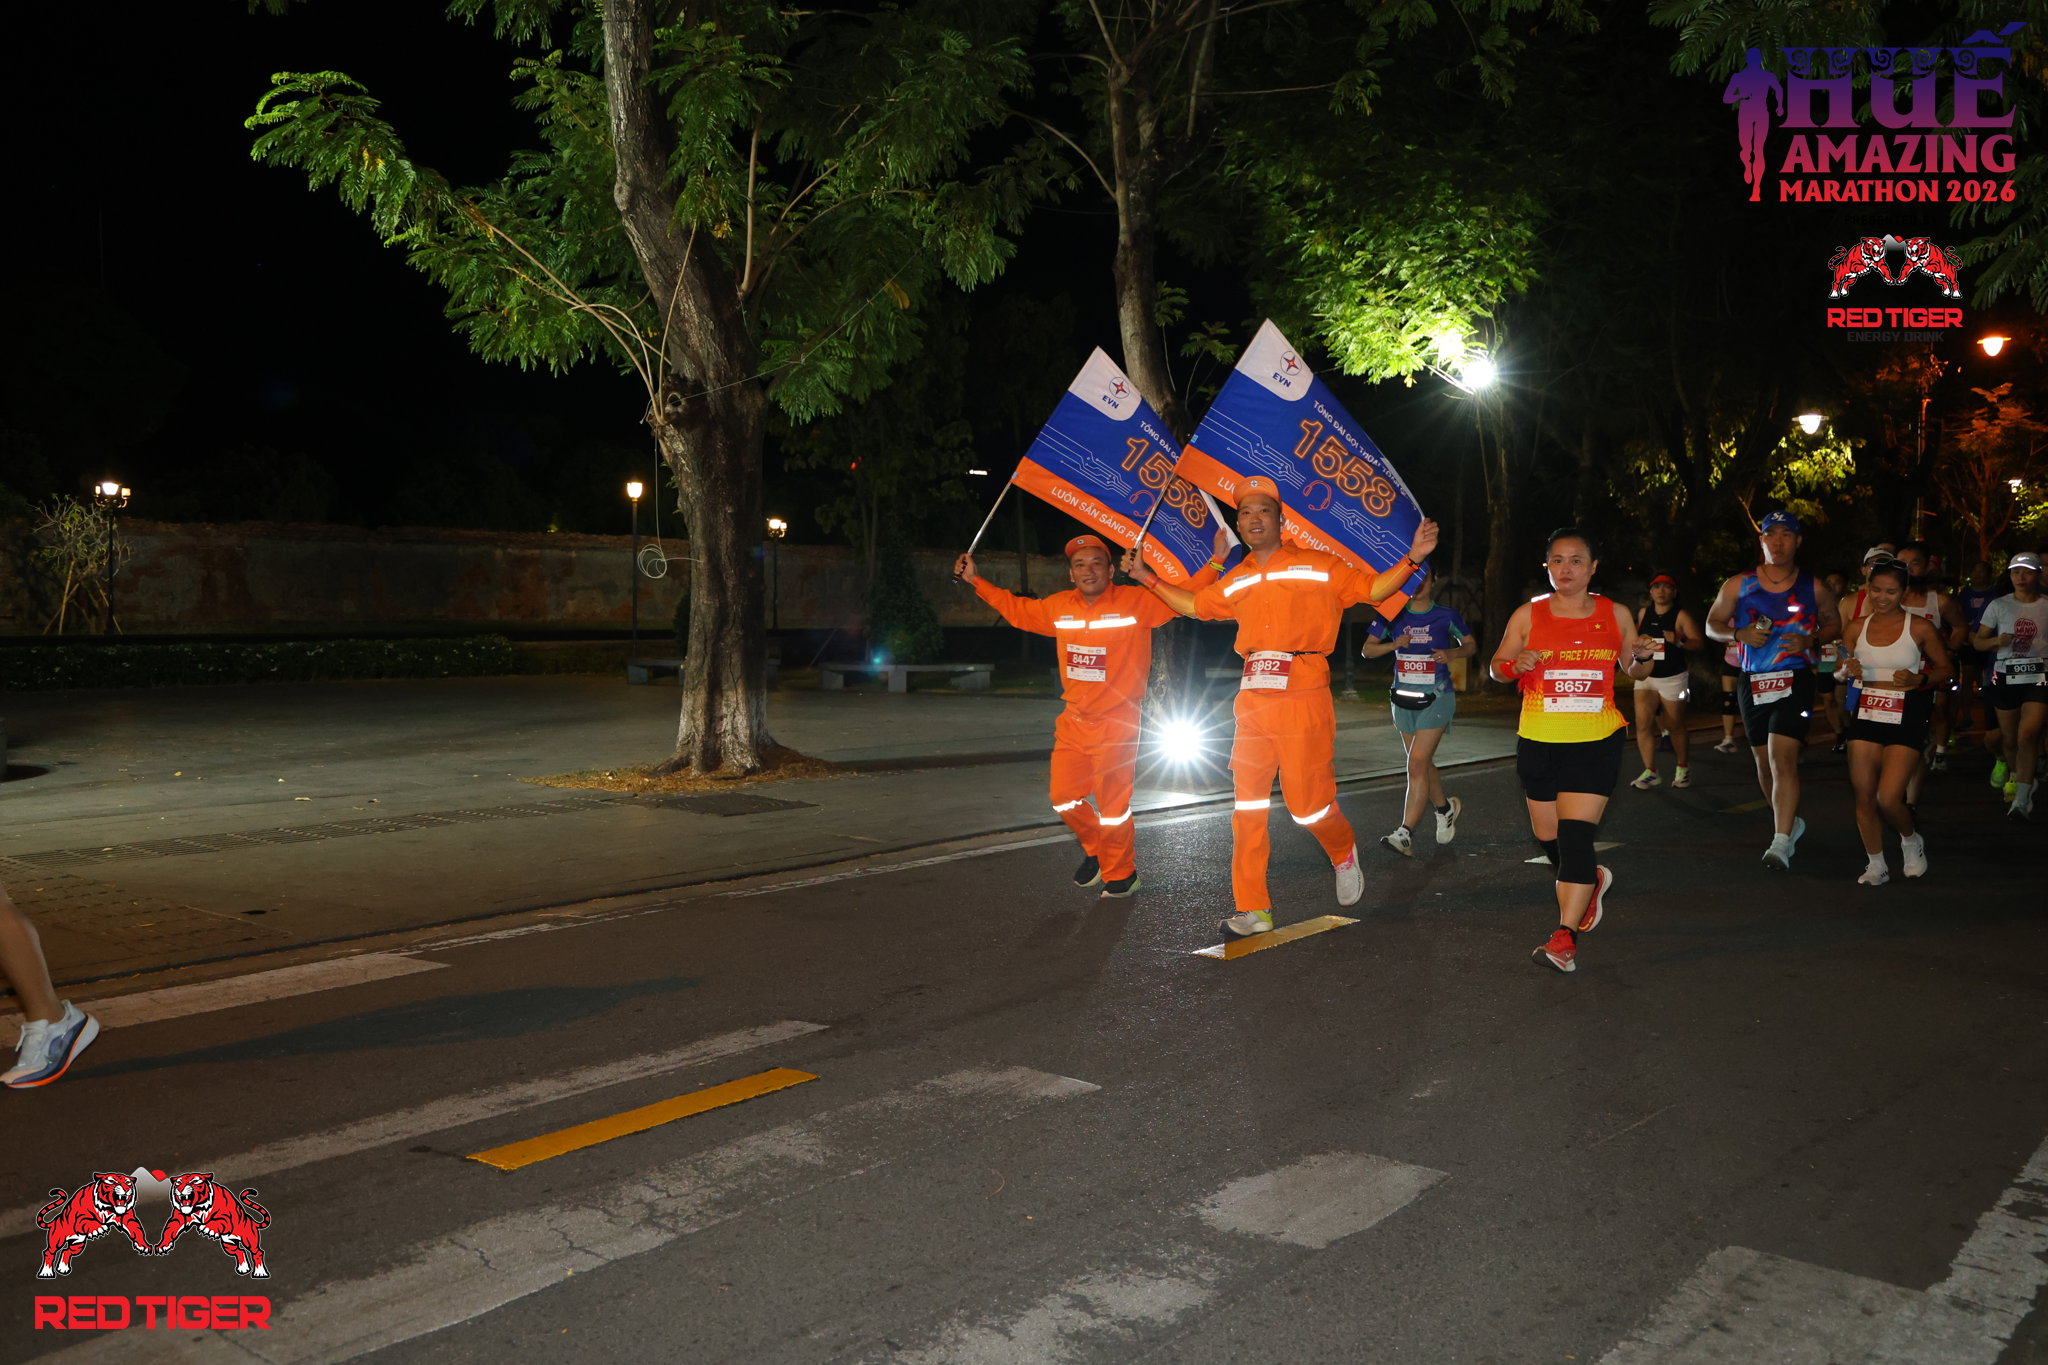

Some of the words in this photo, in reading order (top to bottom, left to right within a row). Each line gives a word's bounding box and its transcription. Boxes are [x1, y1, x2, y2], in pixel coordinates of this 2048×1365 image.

[1272, 372, 1292, 388] EVN
[1102, 394, 1119, 409] EVN
[1294, 419, 1397, 518] 1558
[1121, 437, 1208, 528] 1558
[1051, 486, 1079, 507] LUÔN
[1099, 514, 1126, 534] SÀNG
[1164, 561, 1180, 578] 24/7
[1073, 654, 1097, 665] 8447
[1560, 650, 1582, 661] PACE
[1582, 650, 1588, 661] 7
[1588, 649, 1617, 661] FAMILY
[1251, 660, 1280, 672] 8982
[1404, 661, 1426, 671] 8061
[2014, 664, 2036, 673] 9013
[1555, 681, 1592, 692] 8657
[1758, 679, 1785, 690] 8774
[1867, 696, 1893, 708] 8773
